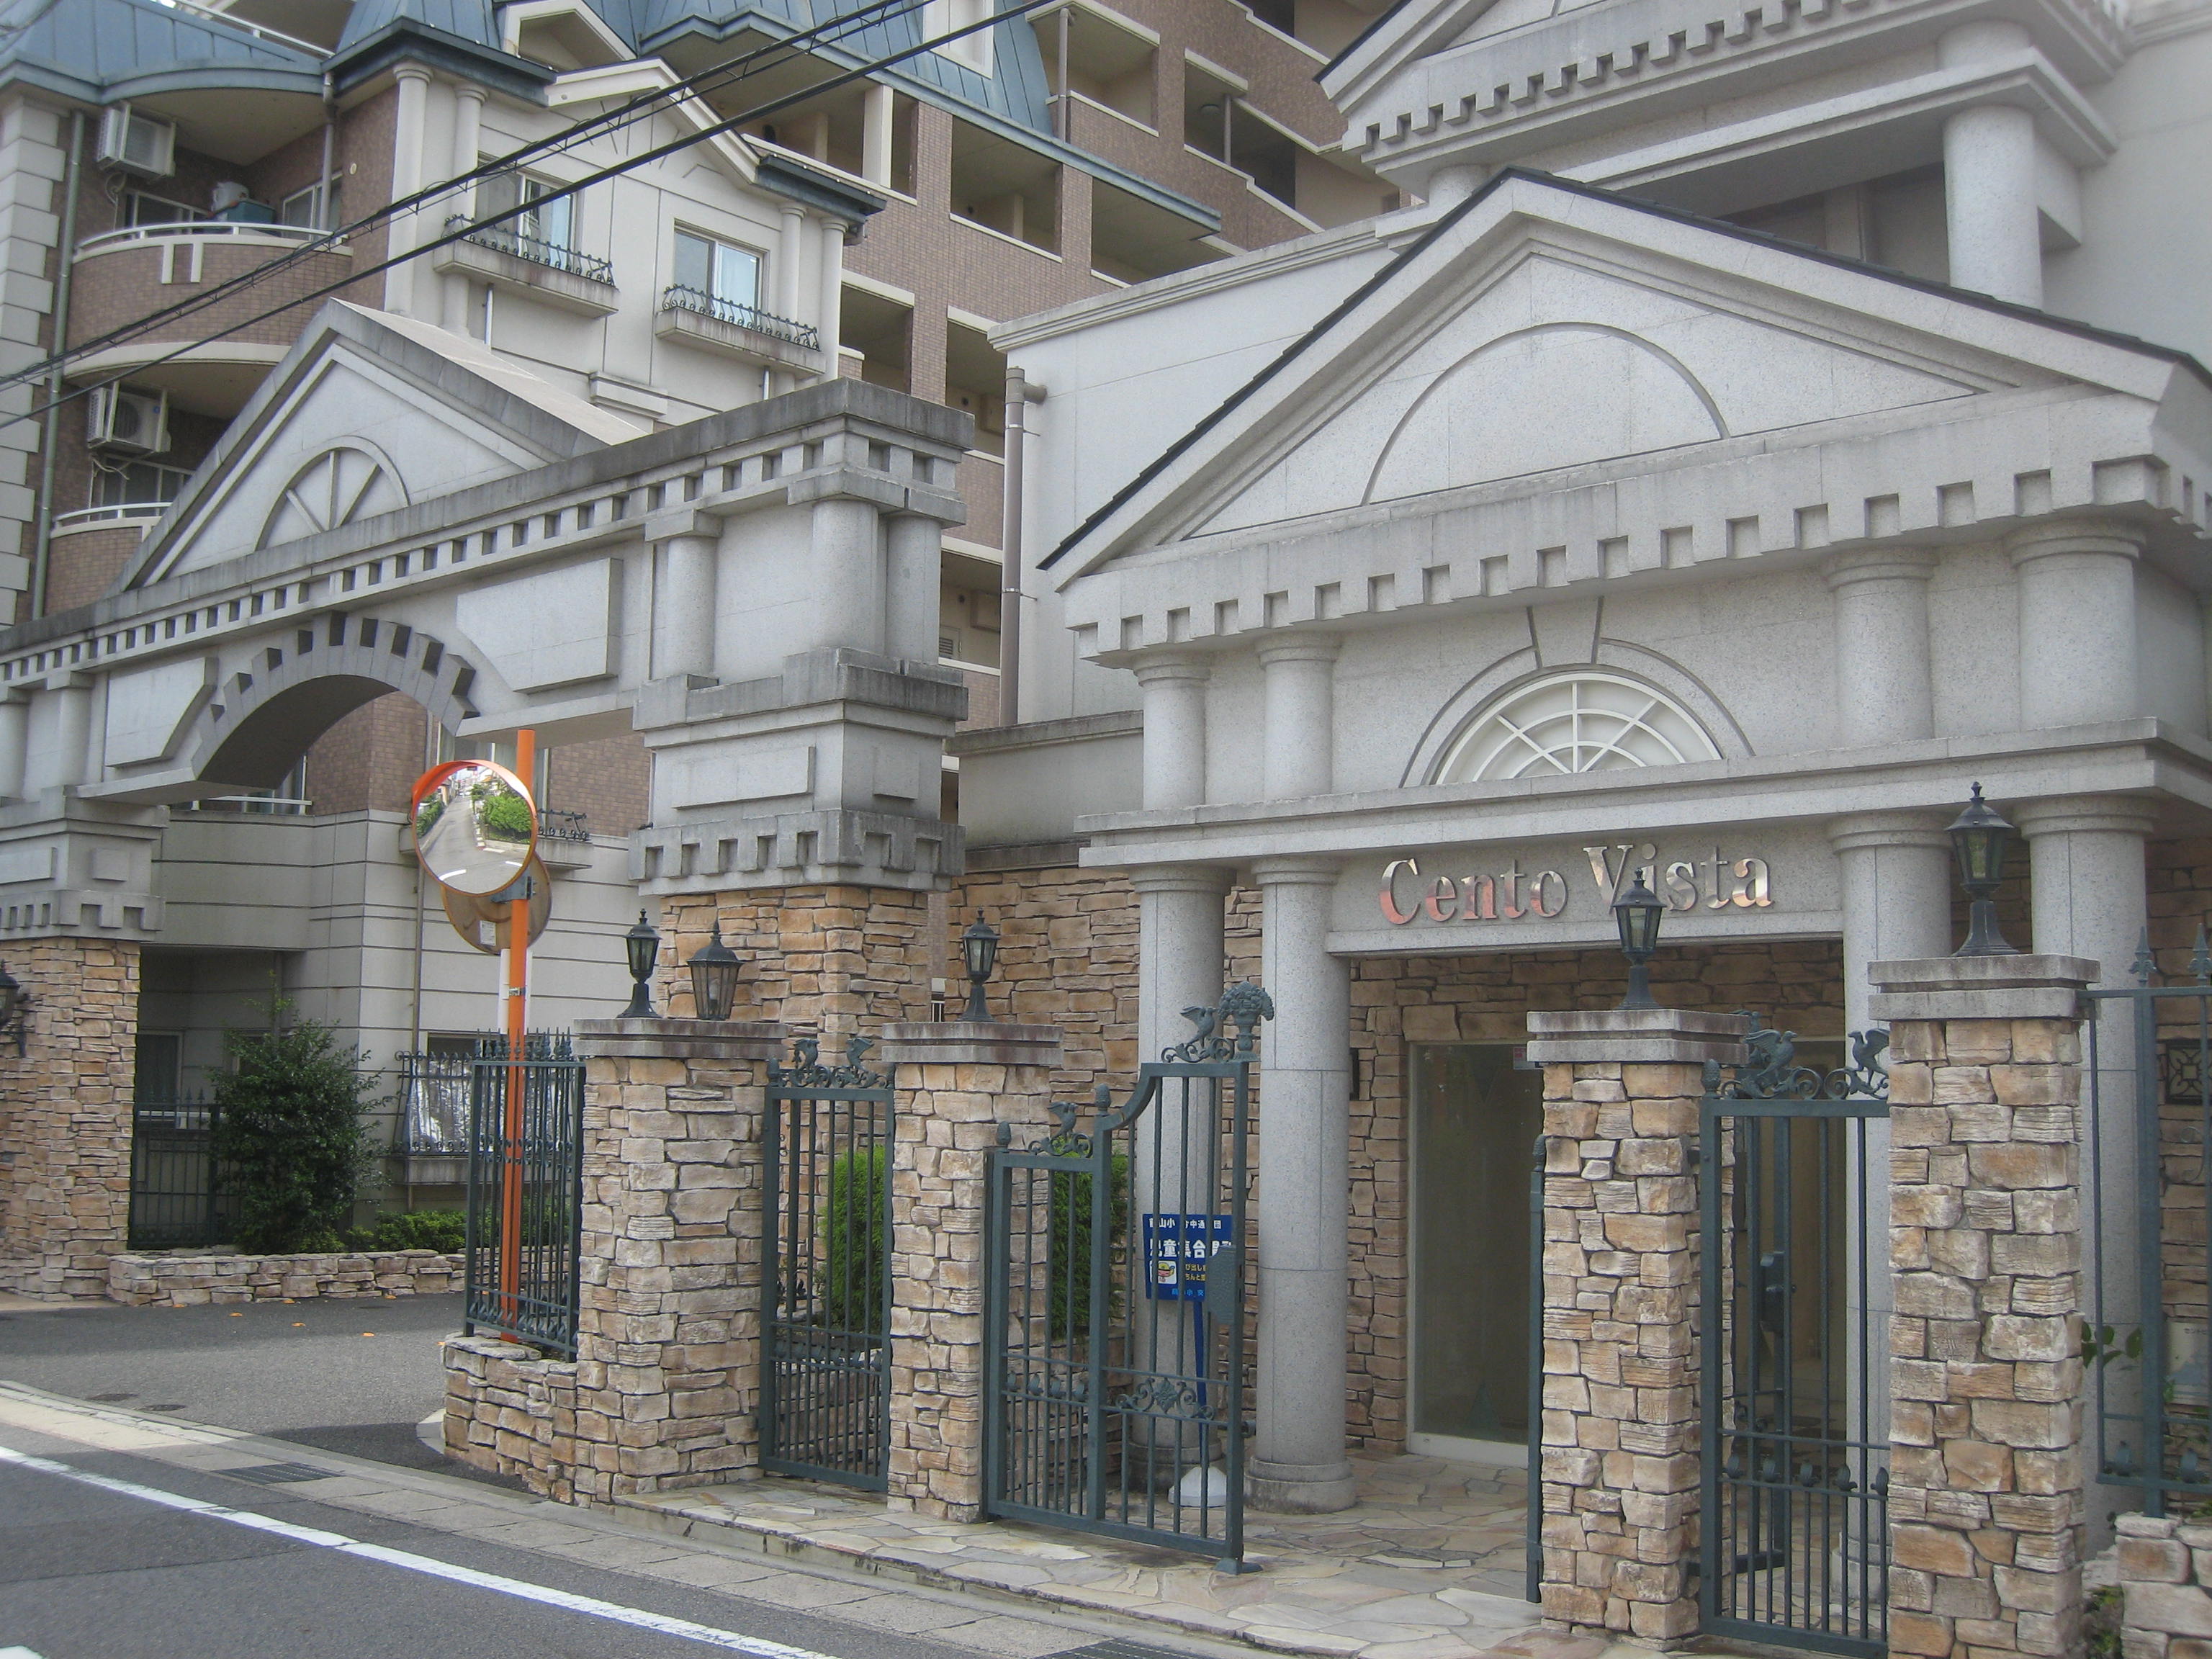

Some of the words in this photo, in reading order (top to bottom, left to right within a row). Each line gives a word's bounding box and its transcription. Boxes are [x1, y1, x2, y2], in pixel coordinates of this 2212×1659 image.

[1379, 858, 1568, 925] Cento
[1583, 843, 1776, 915] Vista
[1149, 1238, 1232, 1259] 童集合
